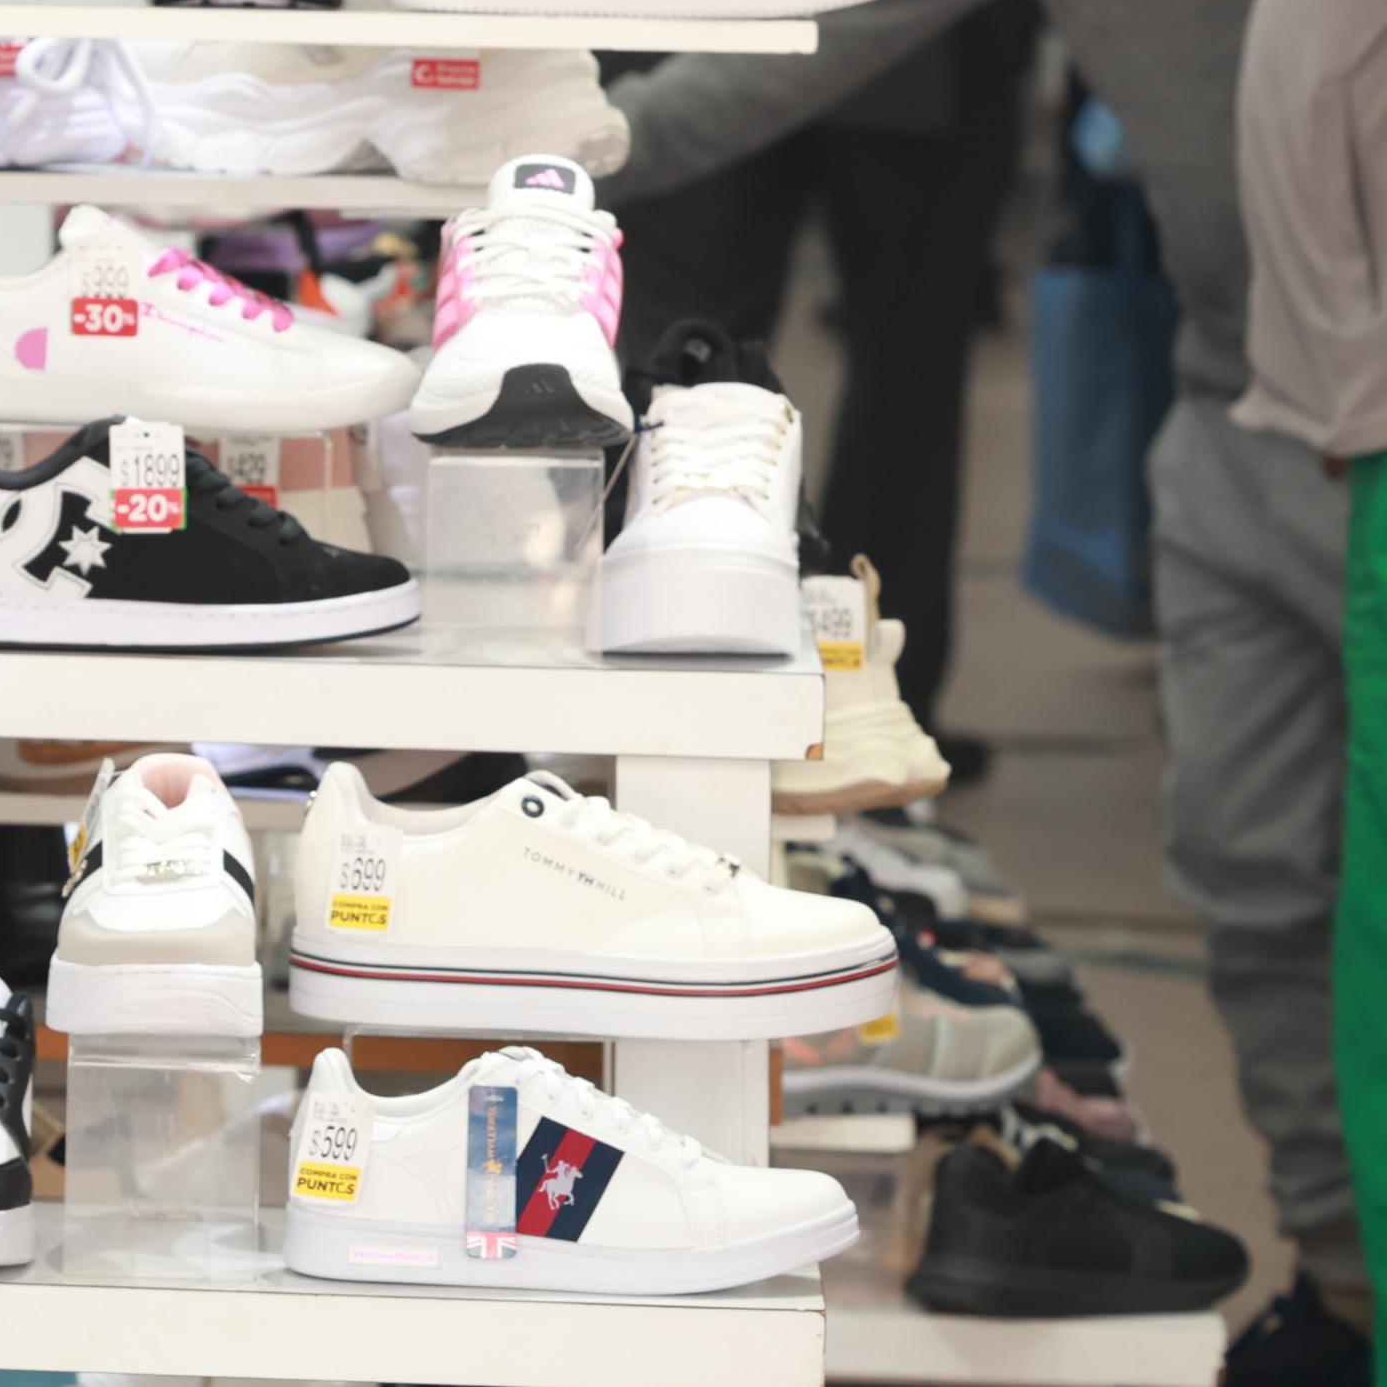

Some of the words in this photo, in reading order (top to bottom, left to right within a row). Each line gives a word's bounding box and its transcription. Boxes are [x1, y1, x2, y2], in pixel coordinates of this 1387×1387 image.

[73, 303, 138, 334] -30%
[119, 453, 181, 488] $1899
[116, 492, 182, 524] -20%
[339, 856, 386, 892] $699
[309, 1125, 358, 1161] $599
[300, 1167, 337, 1180] COMPRA
[339, 1173, 358, 1181] CON
